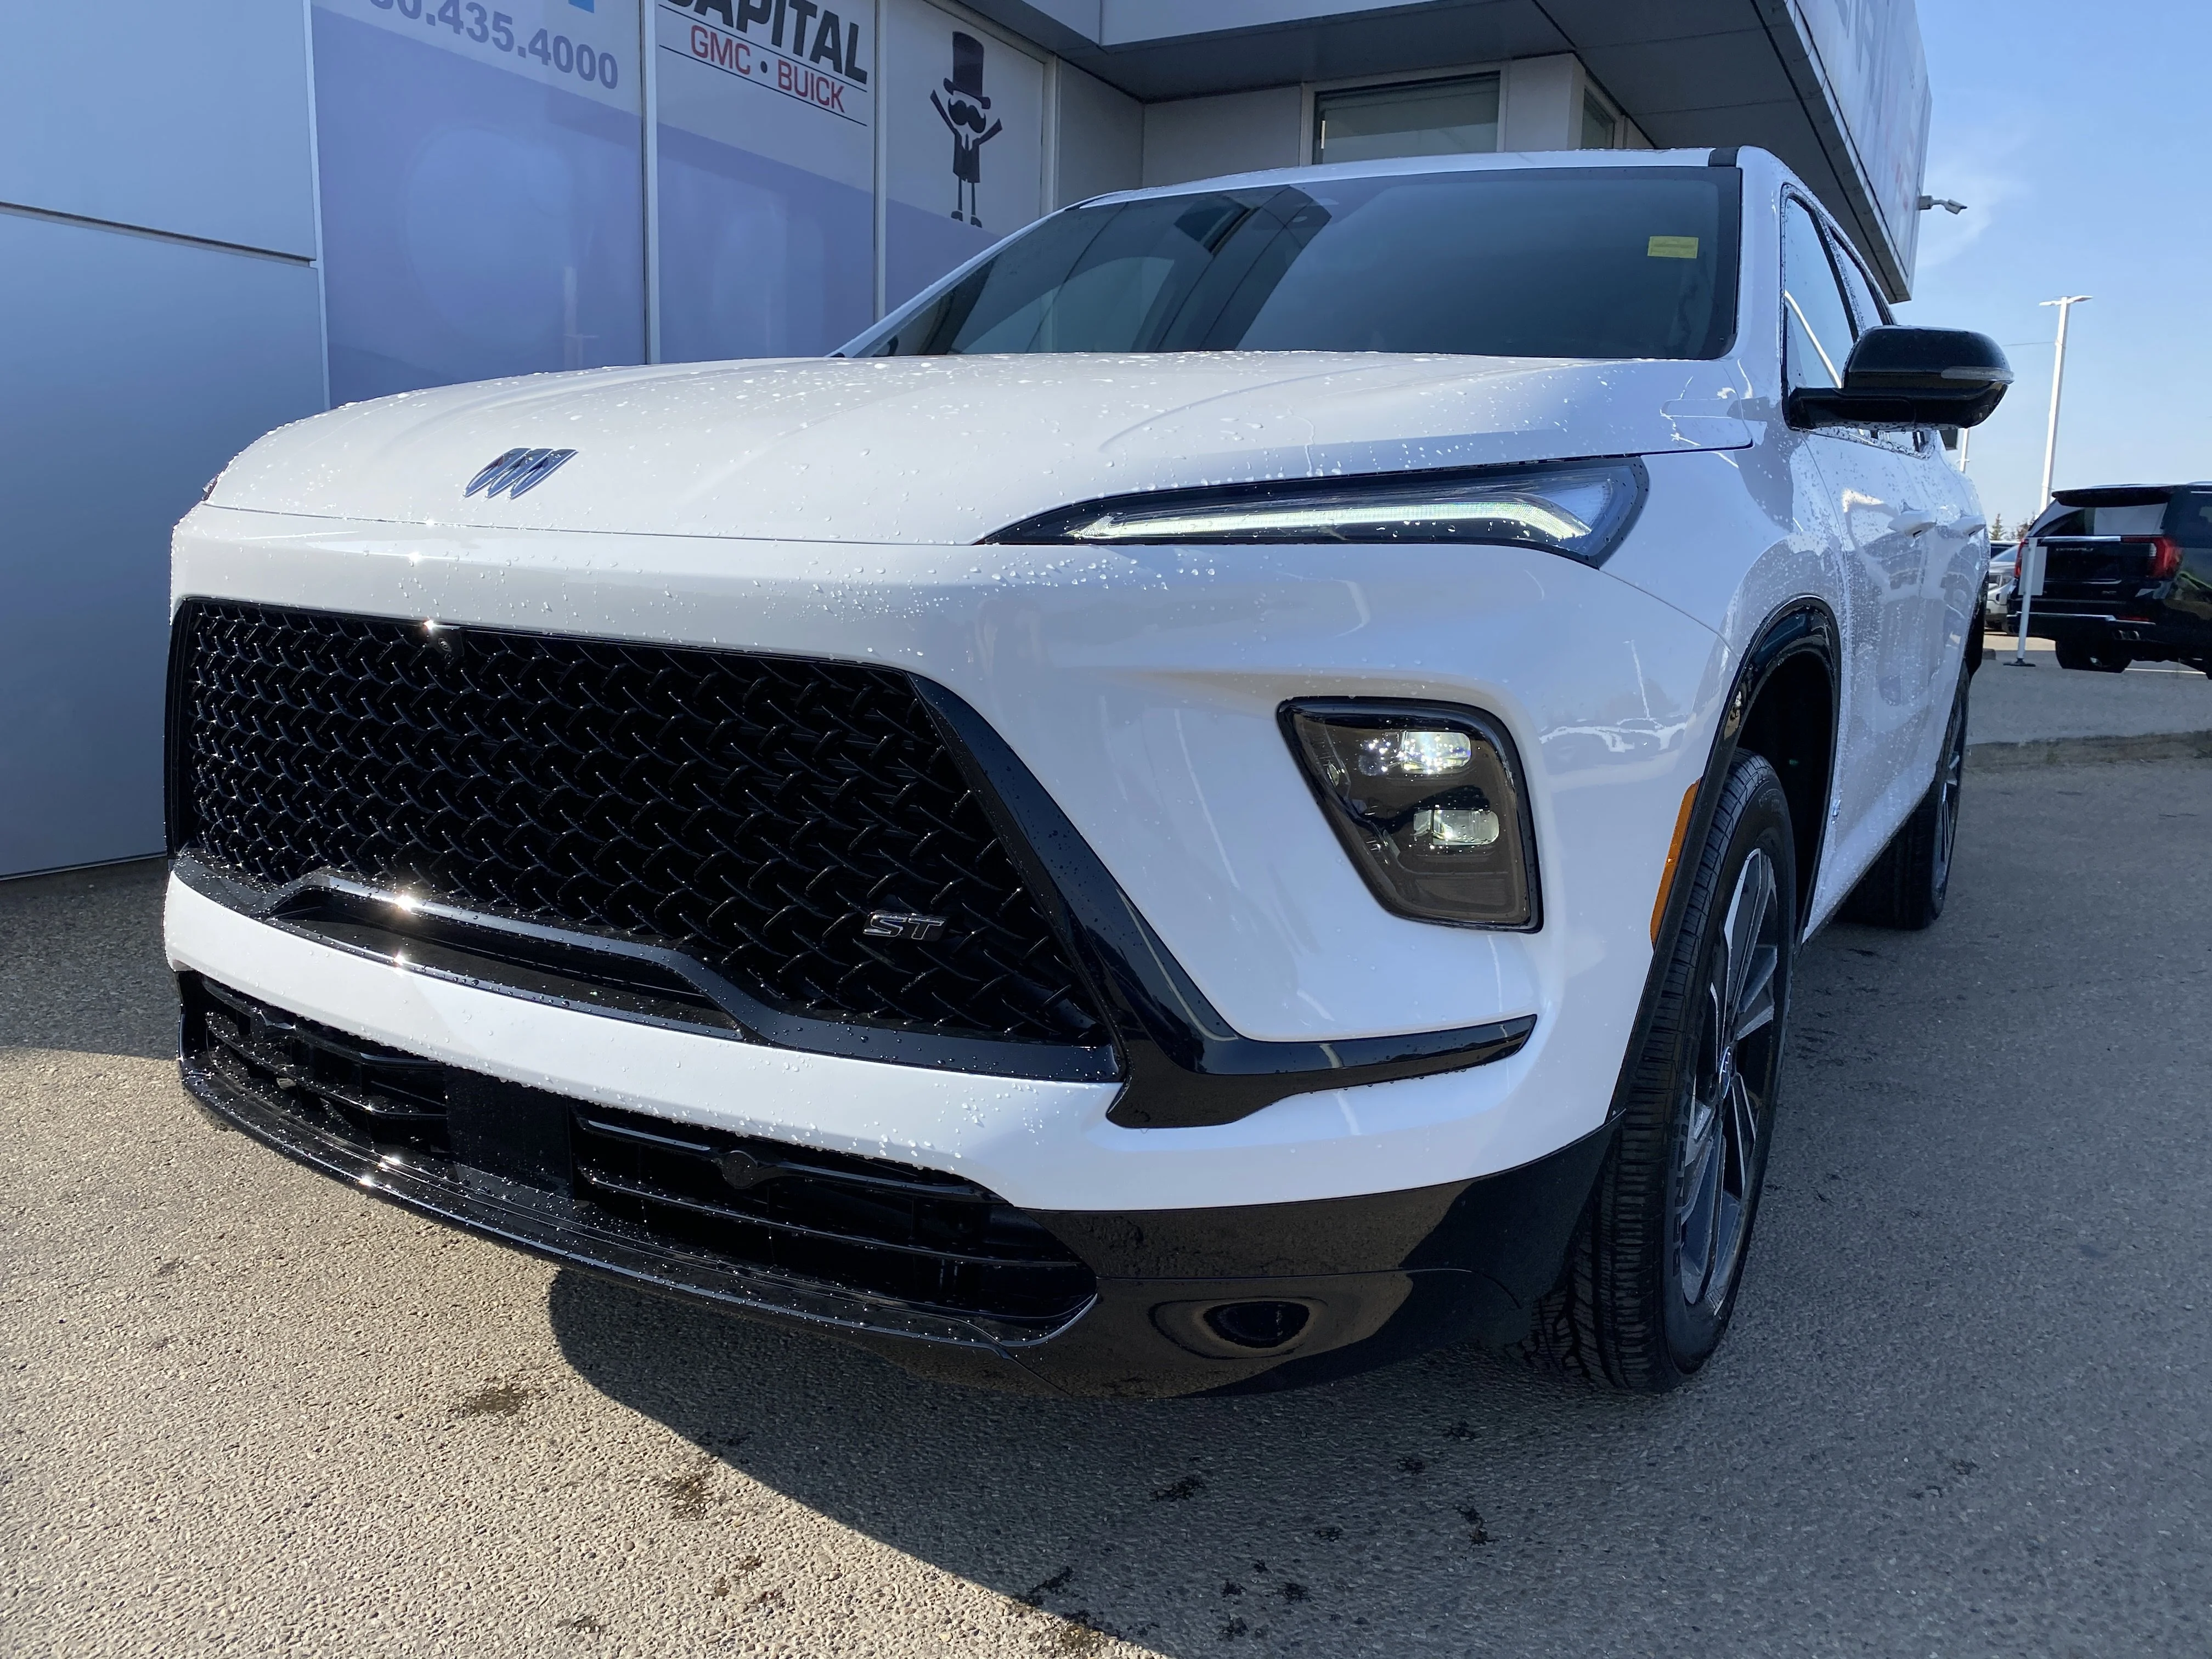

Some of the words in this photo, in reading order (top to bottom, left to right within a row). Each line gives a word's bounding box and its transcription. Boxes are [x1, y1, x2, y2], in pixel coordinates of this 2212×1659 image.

[370, 0, 618, 89] 0.435.4000
[661, 0, 867, 84] PITAL
[691, 25, 751, 75] GMC
[777, 59, 845, 113] BUICK
[863, 912, 946, 940] ST
